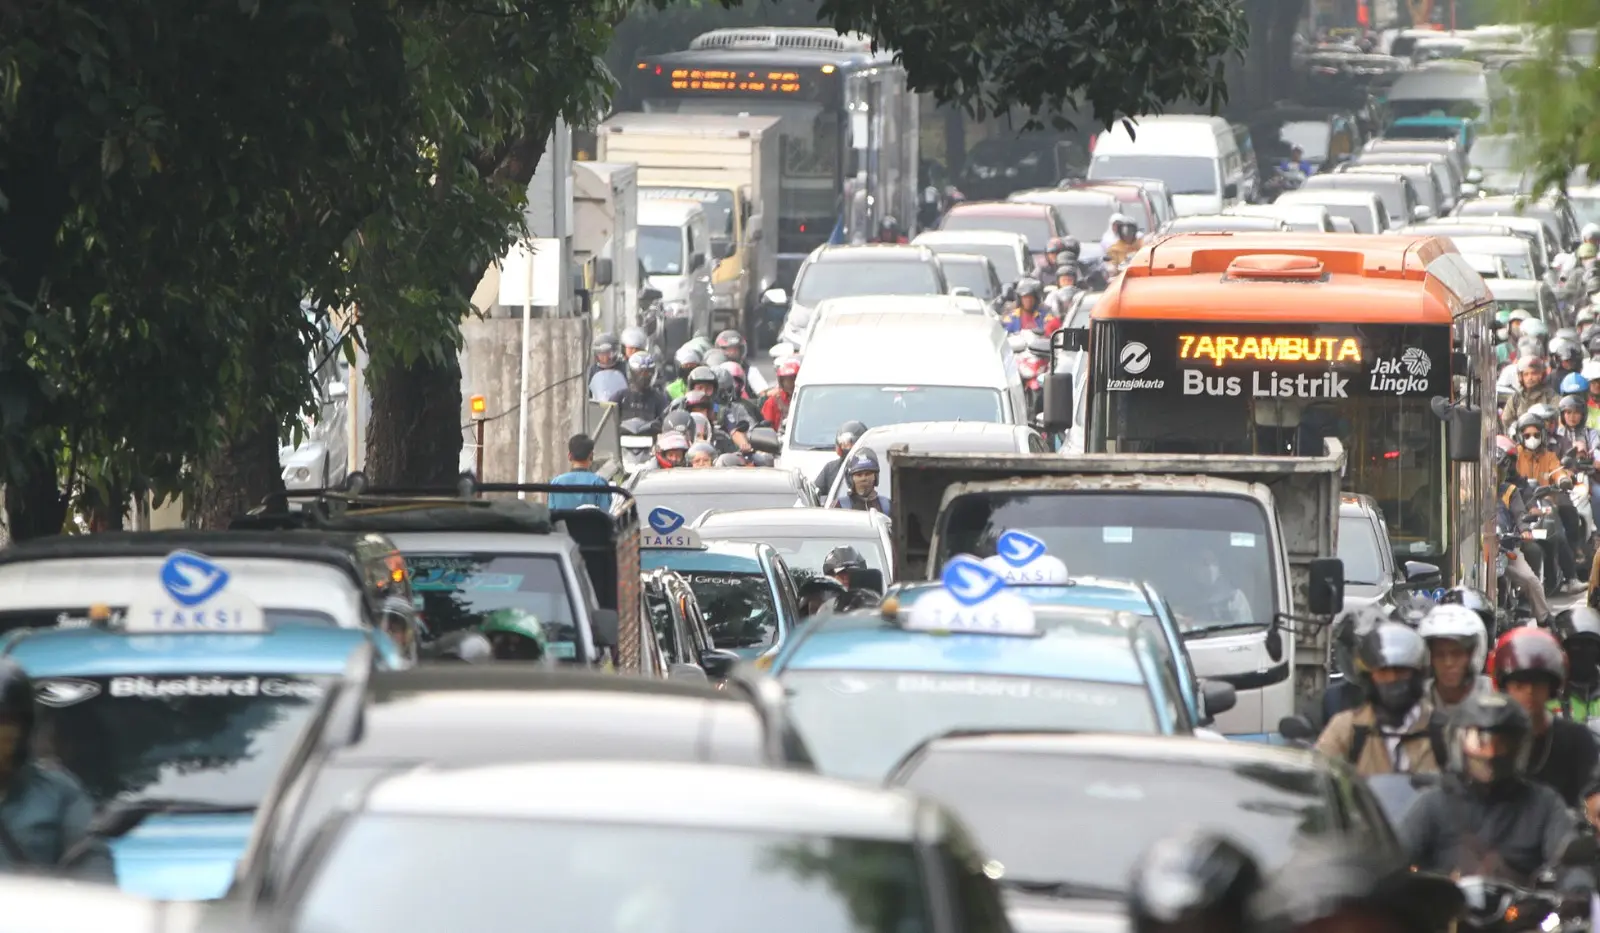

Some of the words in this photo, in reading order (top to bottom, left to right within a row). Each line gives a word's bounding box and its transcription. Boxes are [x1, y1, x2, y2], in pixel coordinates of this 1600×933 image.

[1370, 357, 1402, 374] Jak
[1107, 378, 1164, 390] transjakarta
[1183, 369, 1241, 396] Bus
[1252, 371, 1349, 398] Listrik
[1370, 374, 1429, 395] Lingko
[644, 536, 690, 546] TAKSI
[695, 575, 742, 587] Group
[1003, 570, 1054, 582] AKSI
[151, 609, 242, 627] TAKSI
[110, 676, 259, 698] Bluebird
